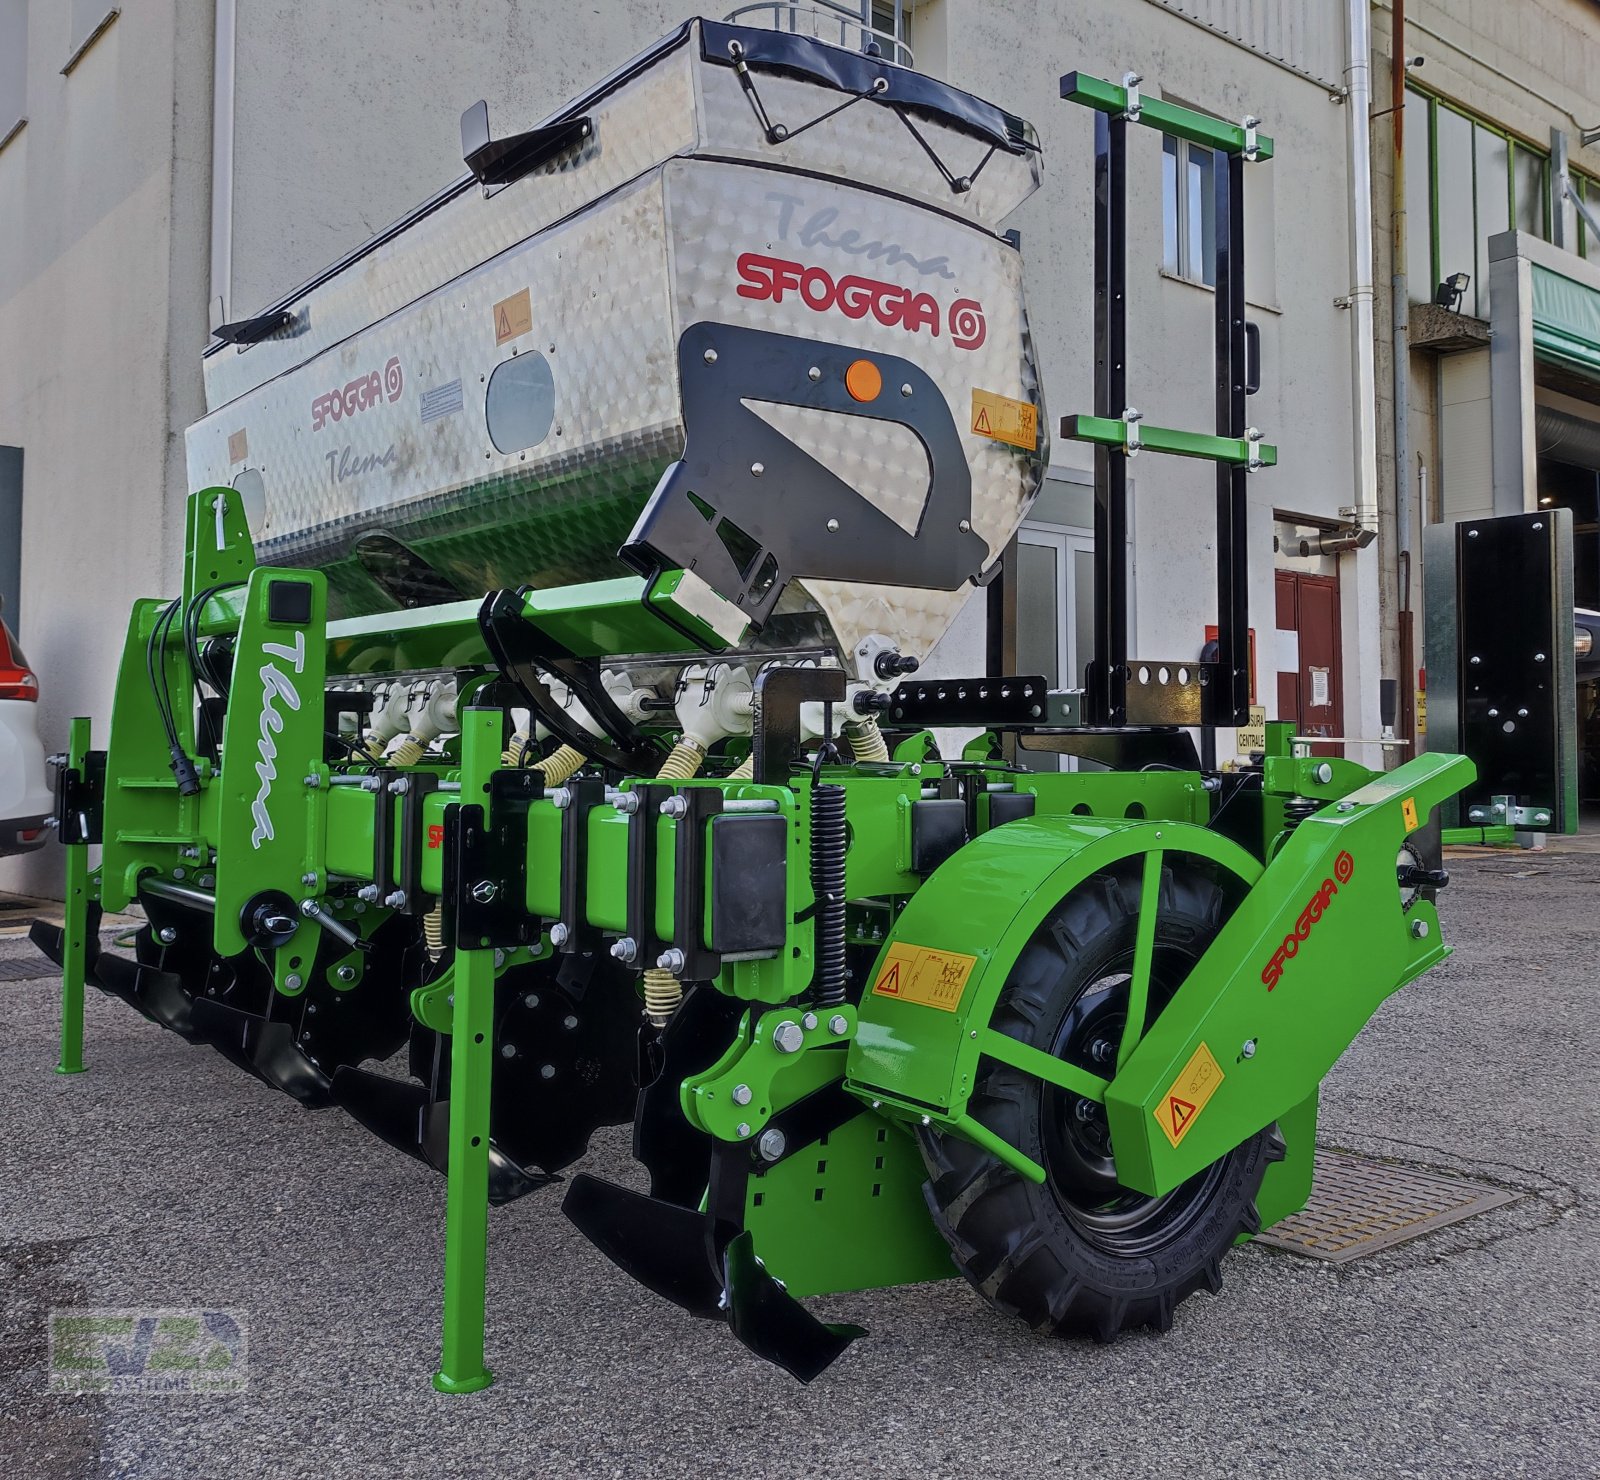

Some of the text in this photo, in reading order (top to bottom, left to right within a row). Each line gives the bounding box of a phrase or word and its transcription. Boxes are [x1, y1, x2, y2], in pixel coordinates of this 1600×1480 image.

[765, 191, 956, 280] Thema
[736, 252, 940, 338] SFOGGIA
[311, 370, 383, 433] SFOGGIA
[325, 444, 397, 485] Thema
[251, 630, 306, 850] Thema
[1239, 733, 1264, 747] CENTRALE
[1248, 714, 1264, 727] SURA
[1261, 878, 1339, 993] SFOGGIA
